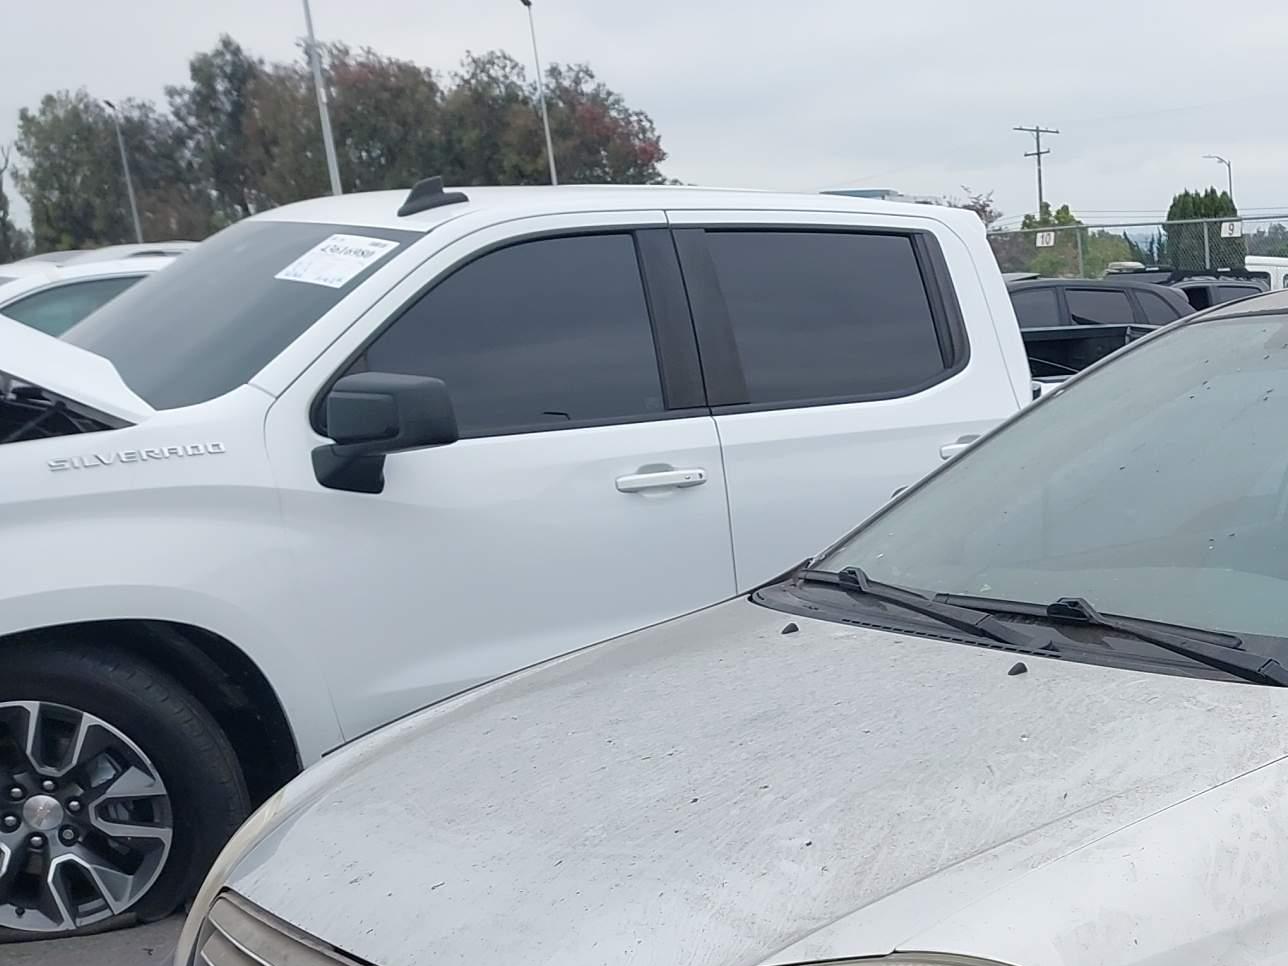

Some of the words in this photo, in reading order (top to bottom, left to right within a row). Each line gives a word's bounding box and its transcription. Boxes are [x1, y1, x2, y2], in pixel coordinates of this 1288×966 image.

[1228, 223, 1235, 236] 9
[1040, 232, 1052, 246] 10
[48, 441, 227, 472] SILVERADO
